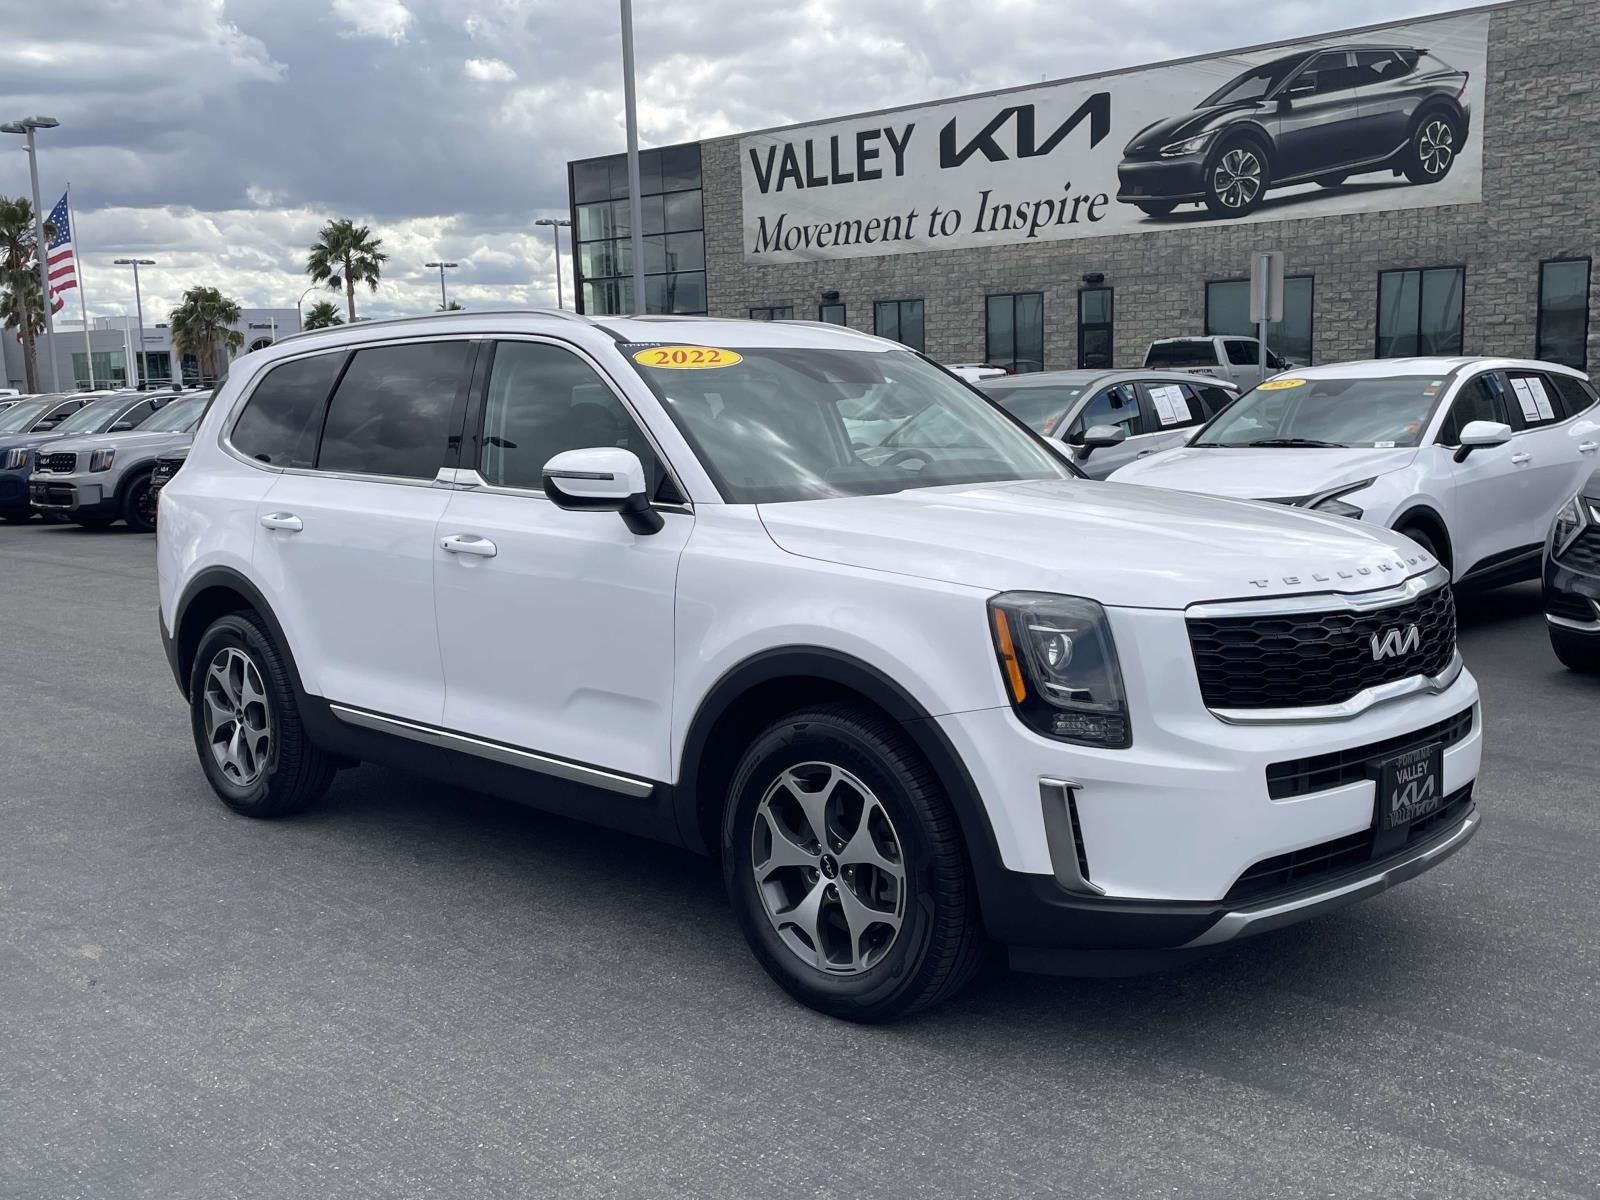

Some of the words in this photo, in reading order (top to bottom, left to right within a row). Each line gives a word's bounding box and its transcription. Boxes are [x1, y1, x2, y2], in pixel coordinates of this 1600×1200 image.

[749, 122, 916, 194] VALLEY
[939, 91, 1112, 169] KIA
[752, 206, 920, 254] Movement
[928, 204, 962, 237] to
[971, 180, 1110, 238] Inspire
[655, 350, 721, 365] 2022
[1249, 554, 1428, 588] TELLURIDE
[1369, 623, 1420, 661] KIA
[1396, 760, 1429, 785] VALLEY
[1392, 774, 1435, 812] KIA
